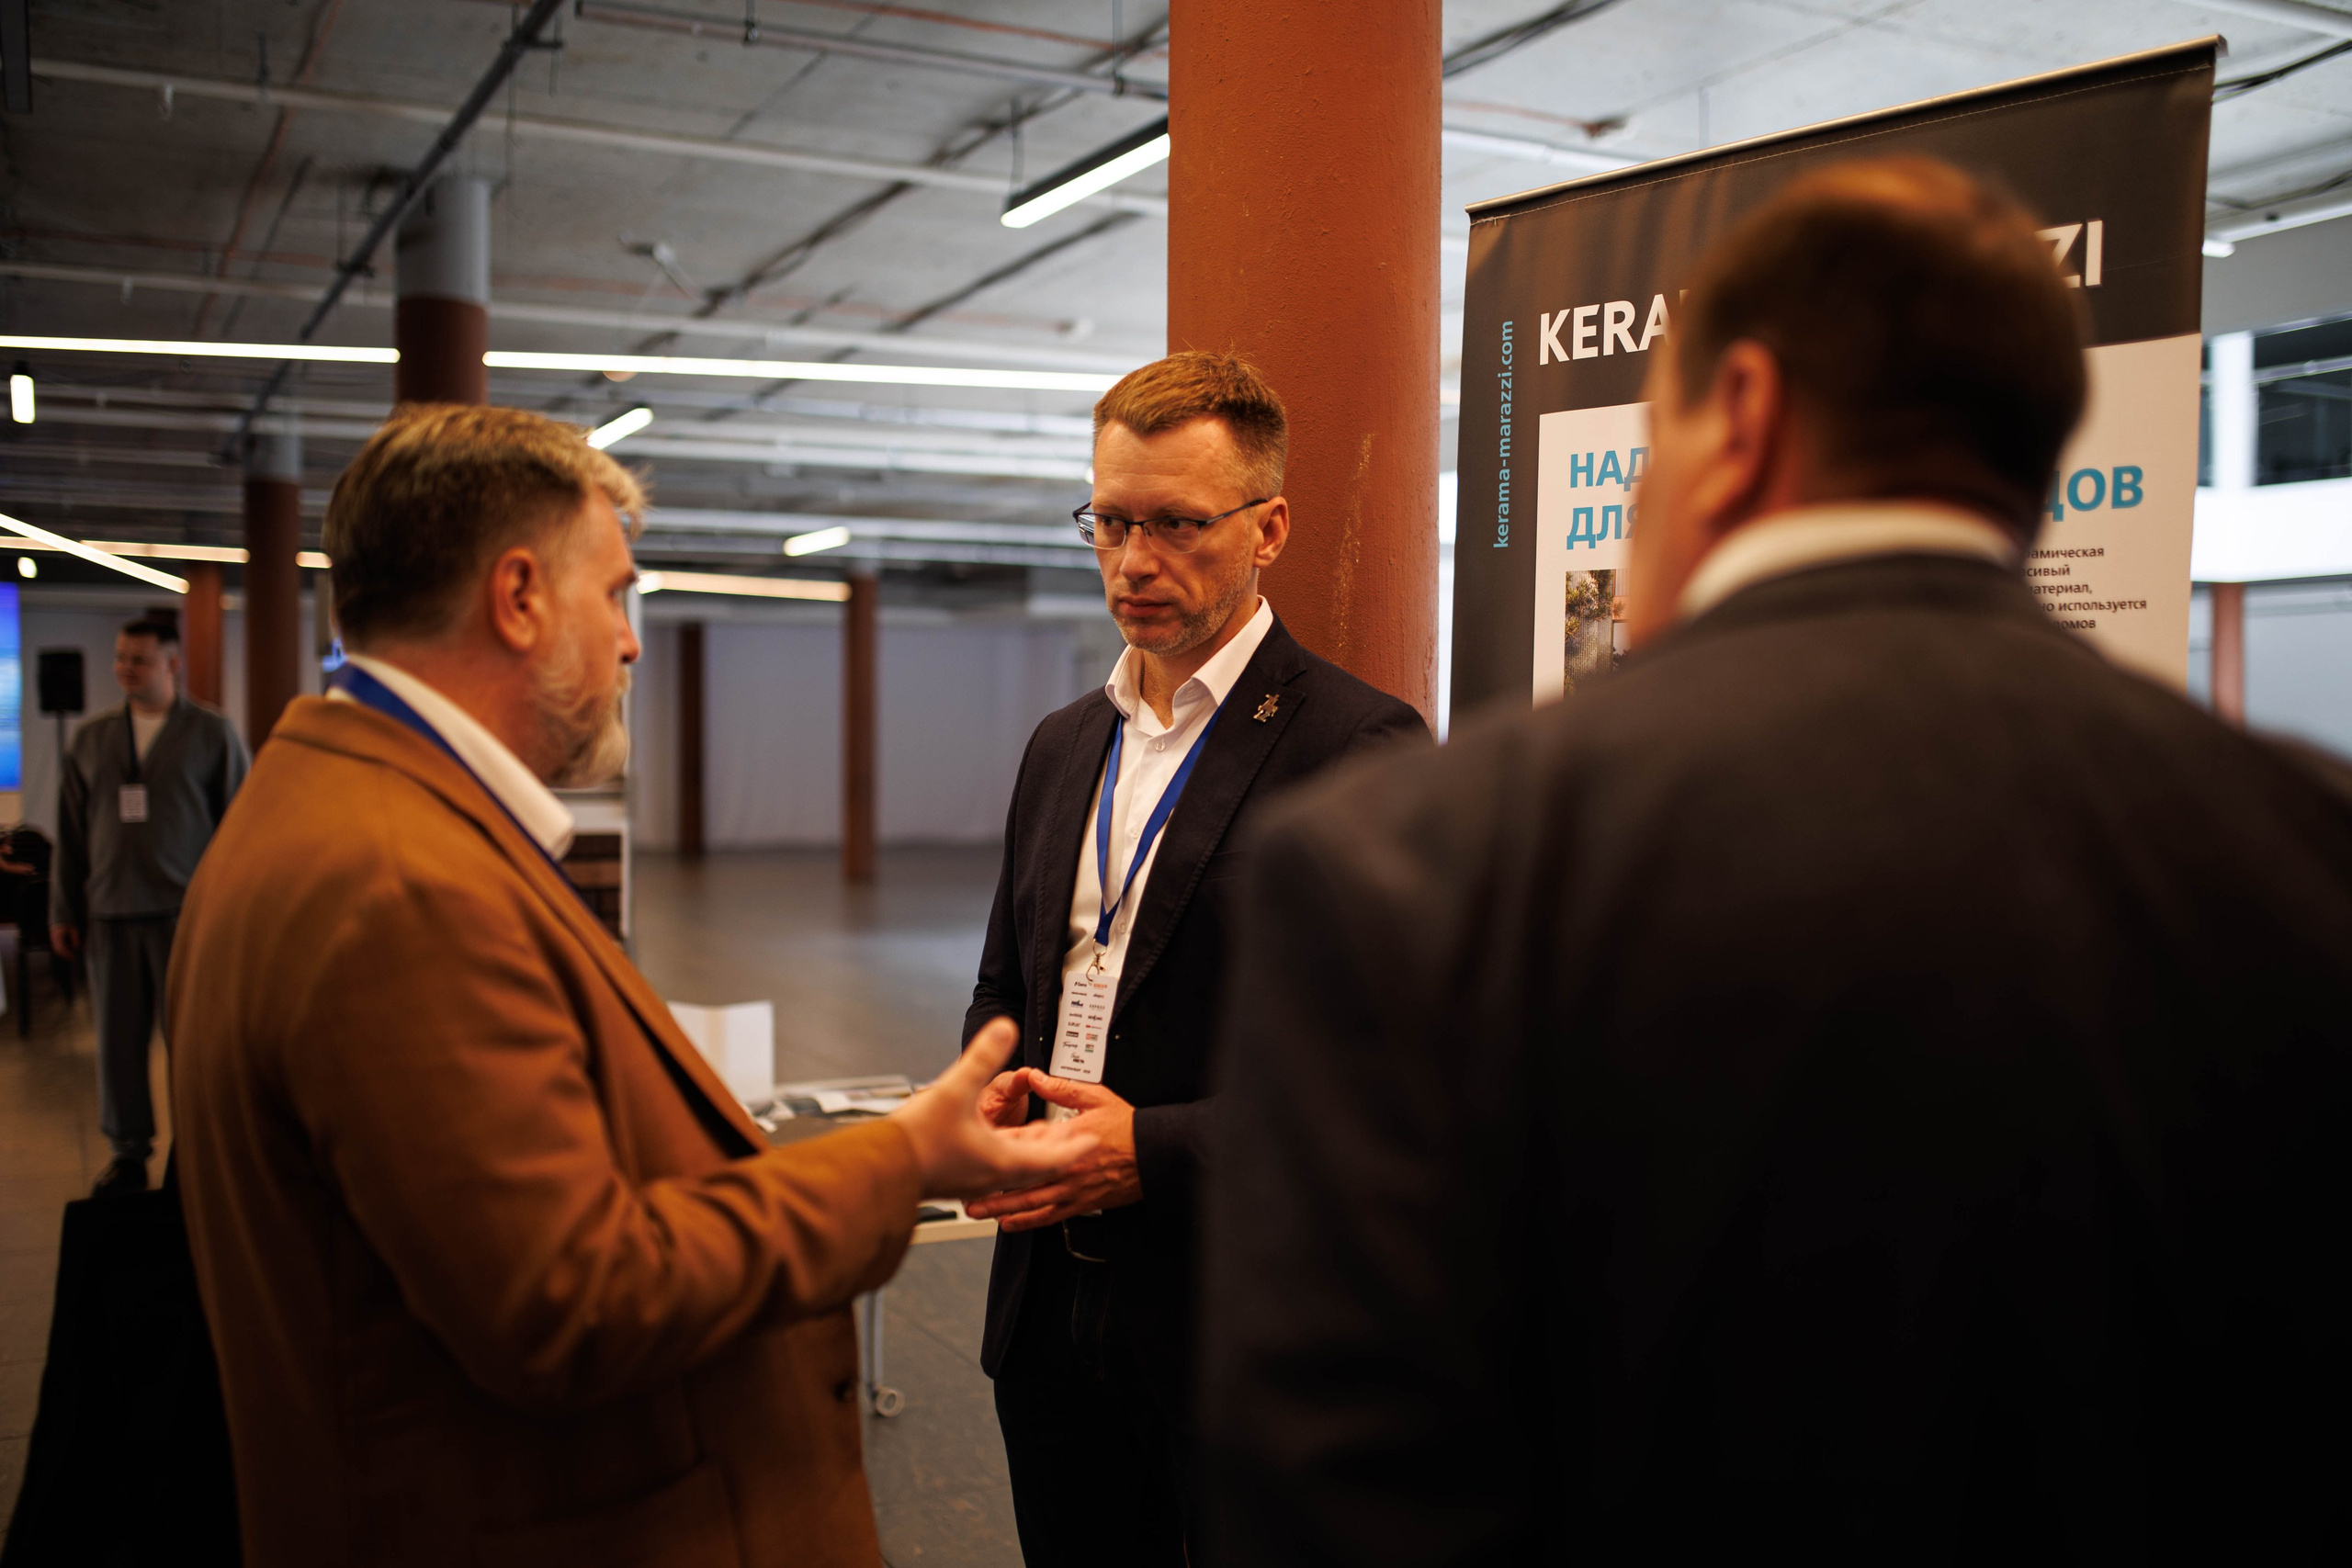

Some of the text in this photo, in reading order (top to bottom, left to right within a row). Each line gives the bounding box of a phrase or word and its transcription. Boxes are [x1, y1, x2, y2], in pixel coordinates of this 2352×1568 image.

[1539, 289, 1689, 366] KERA
[1493, 320, 1514, 549] kerama-marazzi.com
[2030, 583, 2094, 597] атериал,
[2057, 599, 2148, 614] используется
